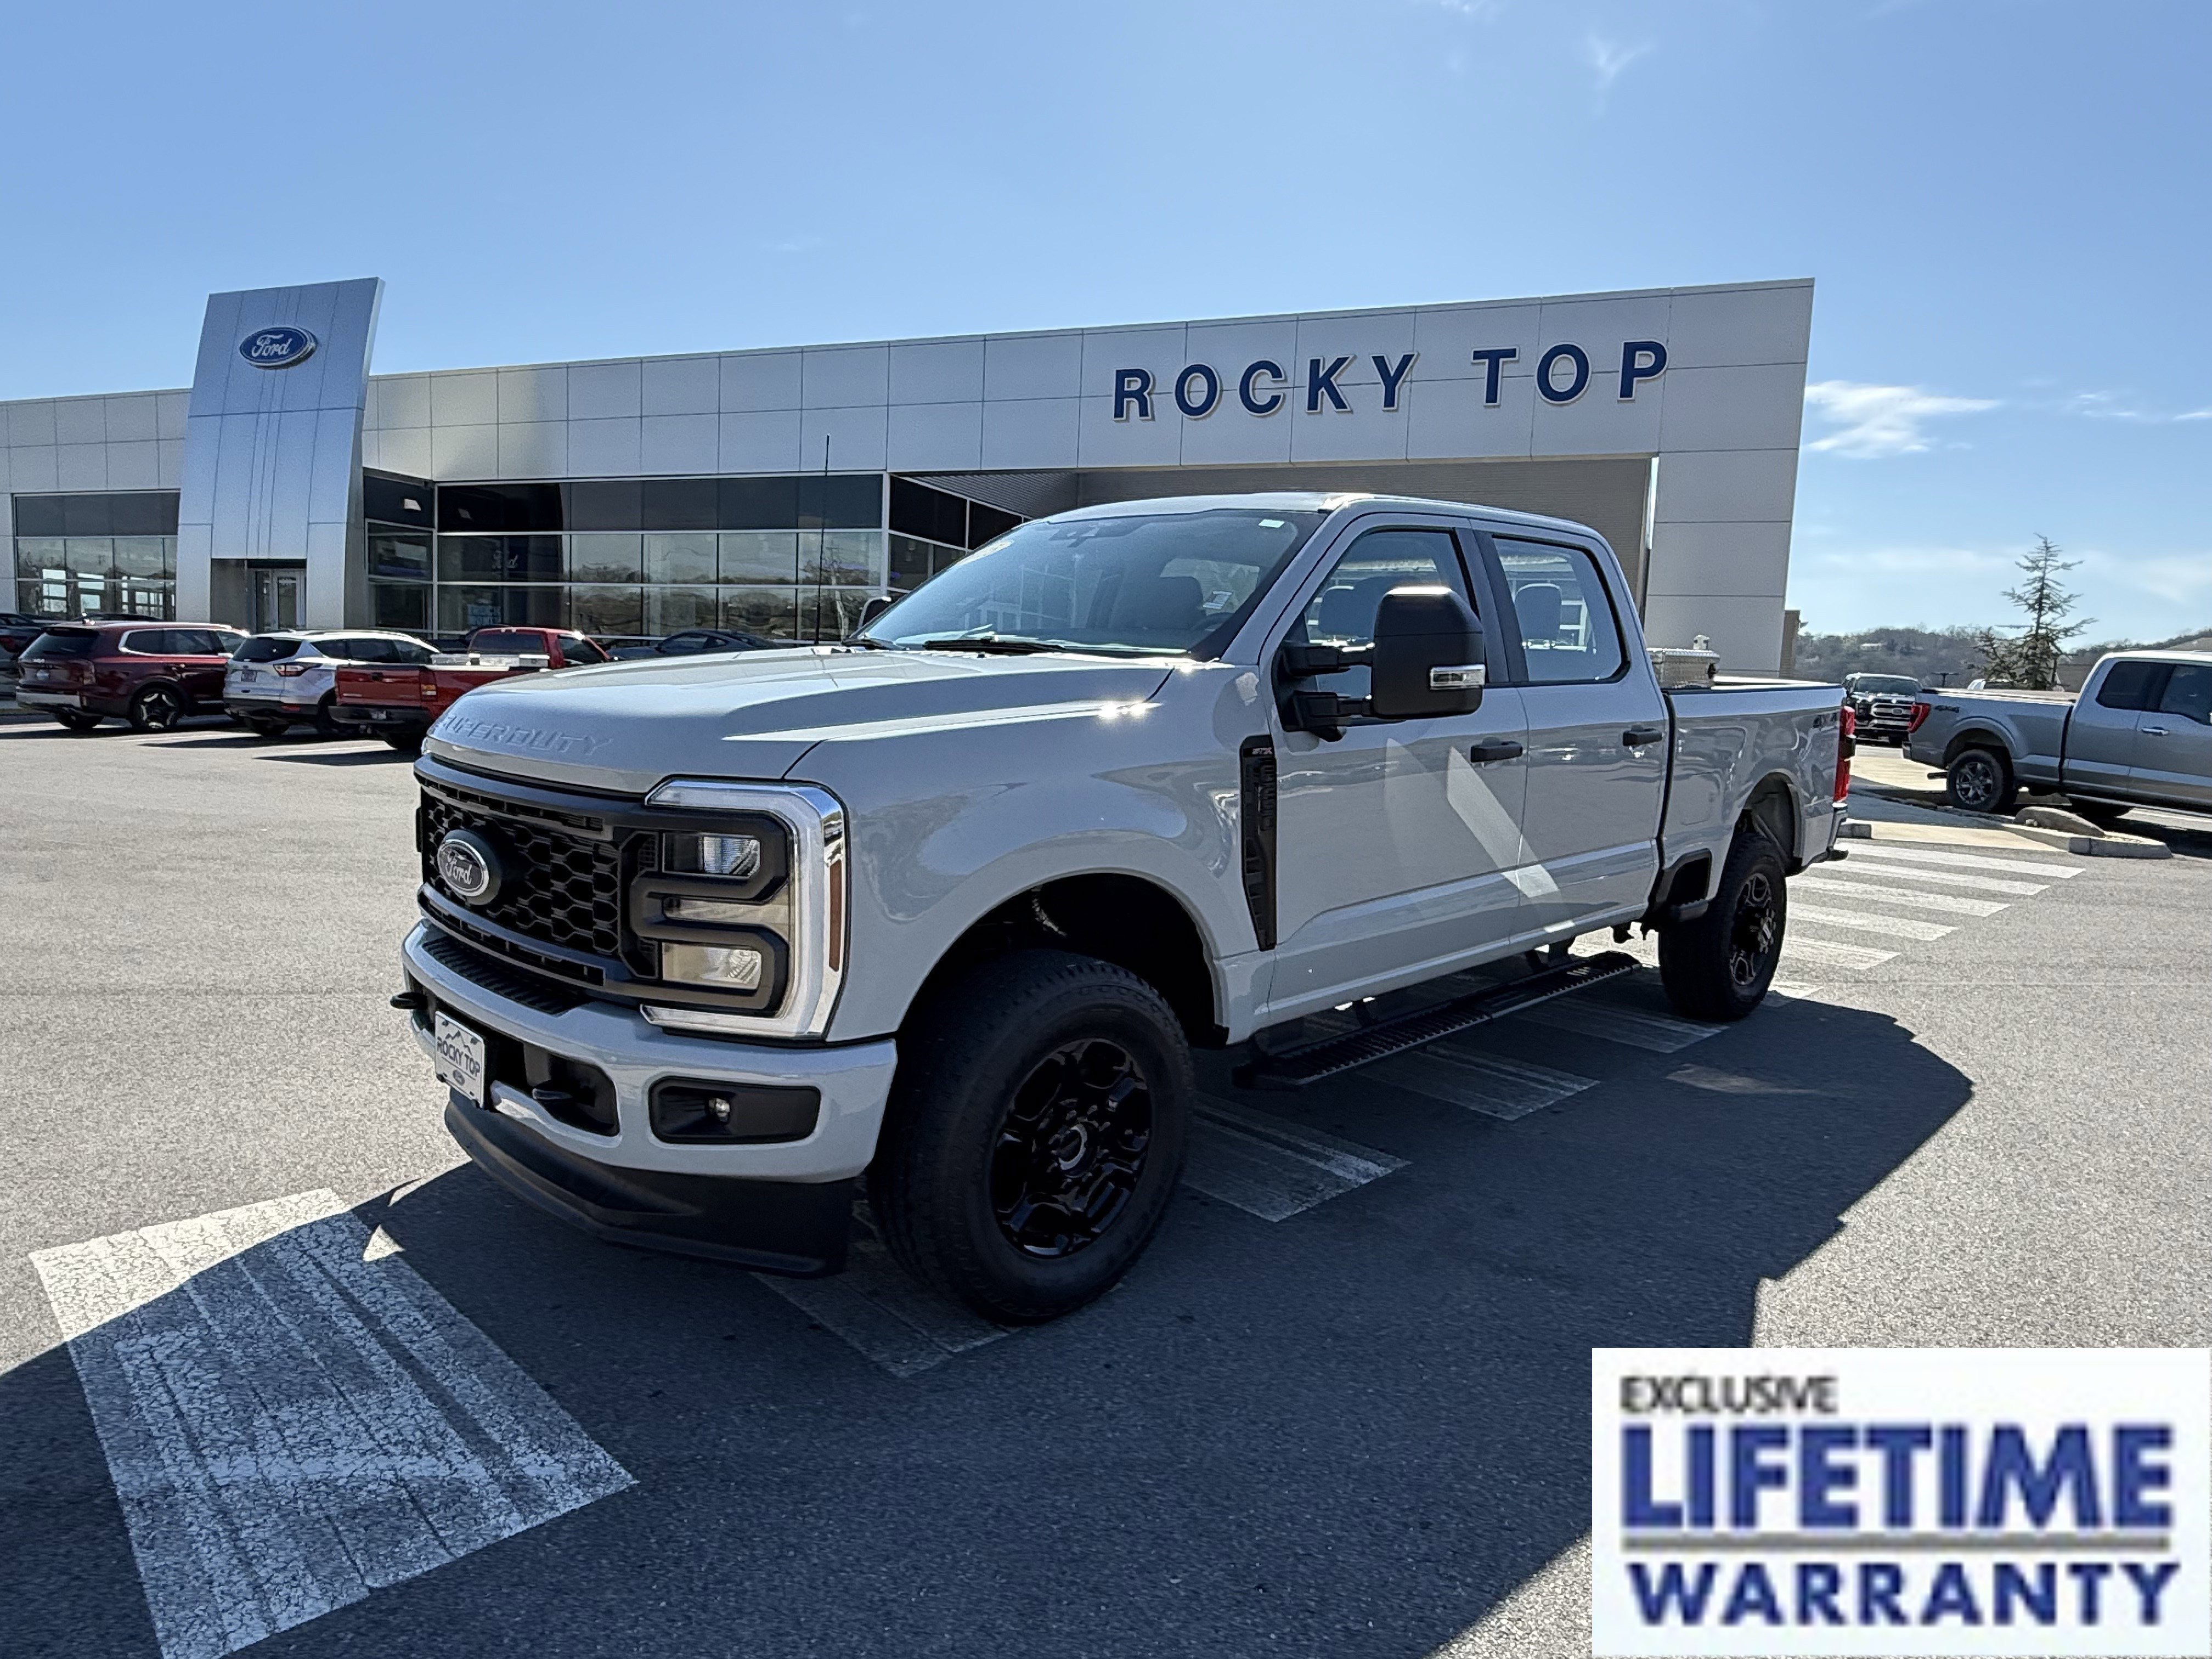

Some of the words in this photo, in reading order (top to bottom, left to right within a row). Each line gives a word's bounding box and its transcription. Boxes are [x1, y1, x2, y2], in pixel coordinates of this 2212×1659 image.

[251, 334, 294, 357] Ford
[1113, 353, 1418, 420] ROCKY
[1471, 341, 1668, 405] TOP
[505, 728, 611, 756] DUTY
[445, 848, 474, 884] Ford
[437, 1036, 464, 1065] ROCKY
[464, 1053, 481, 1077] TOP
